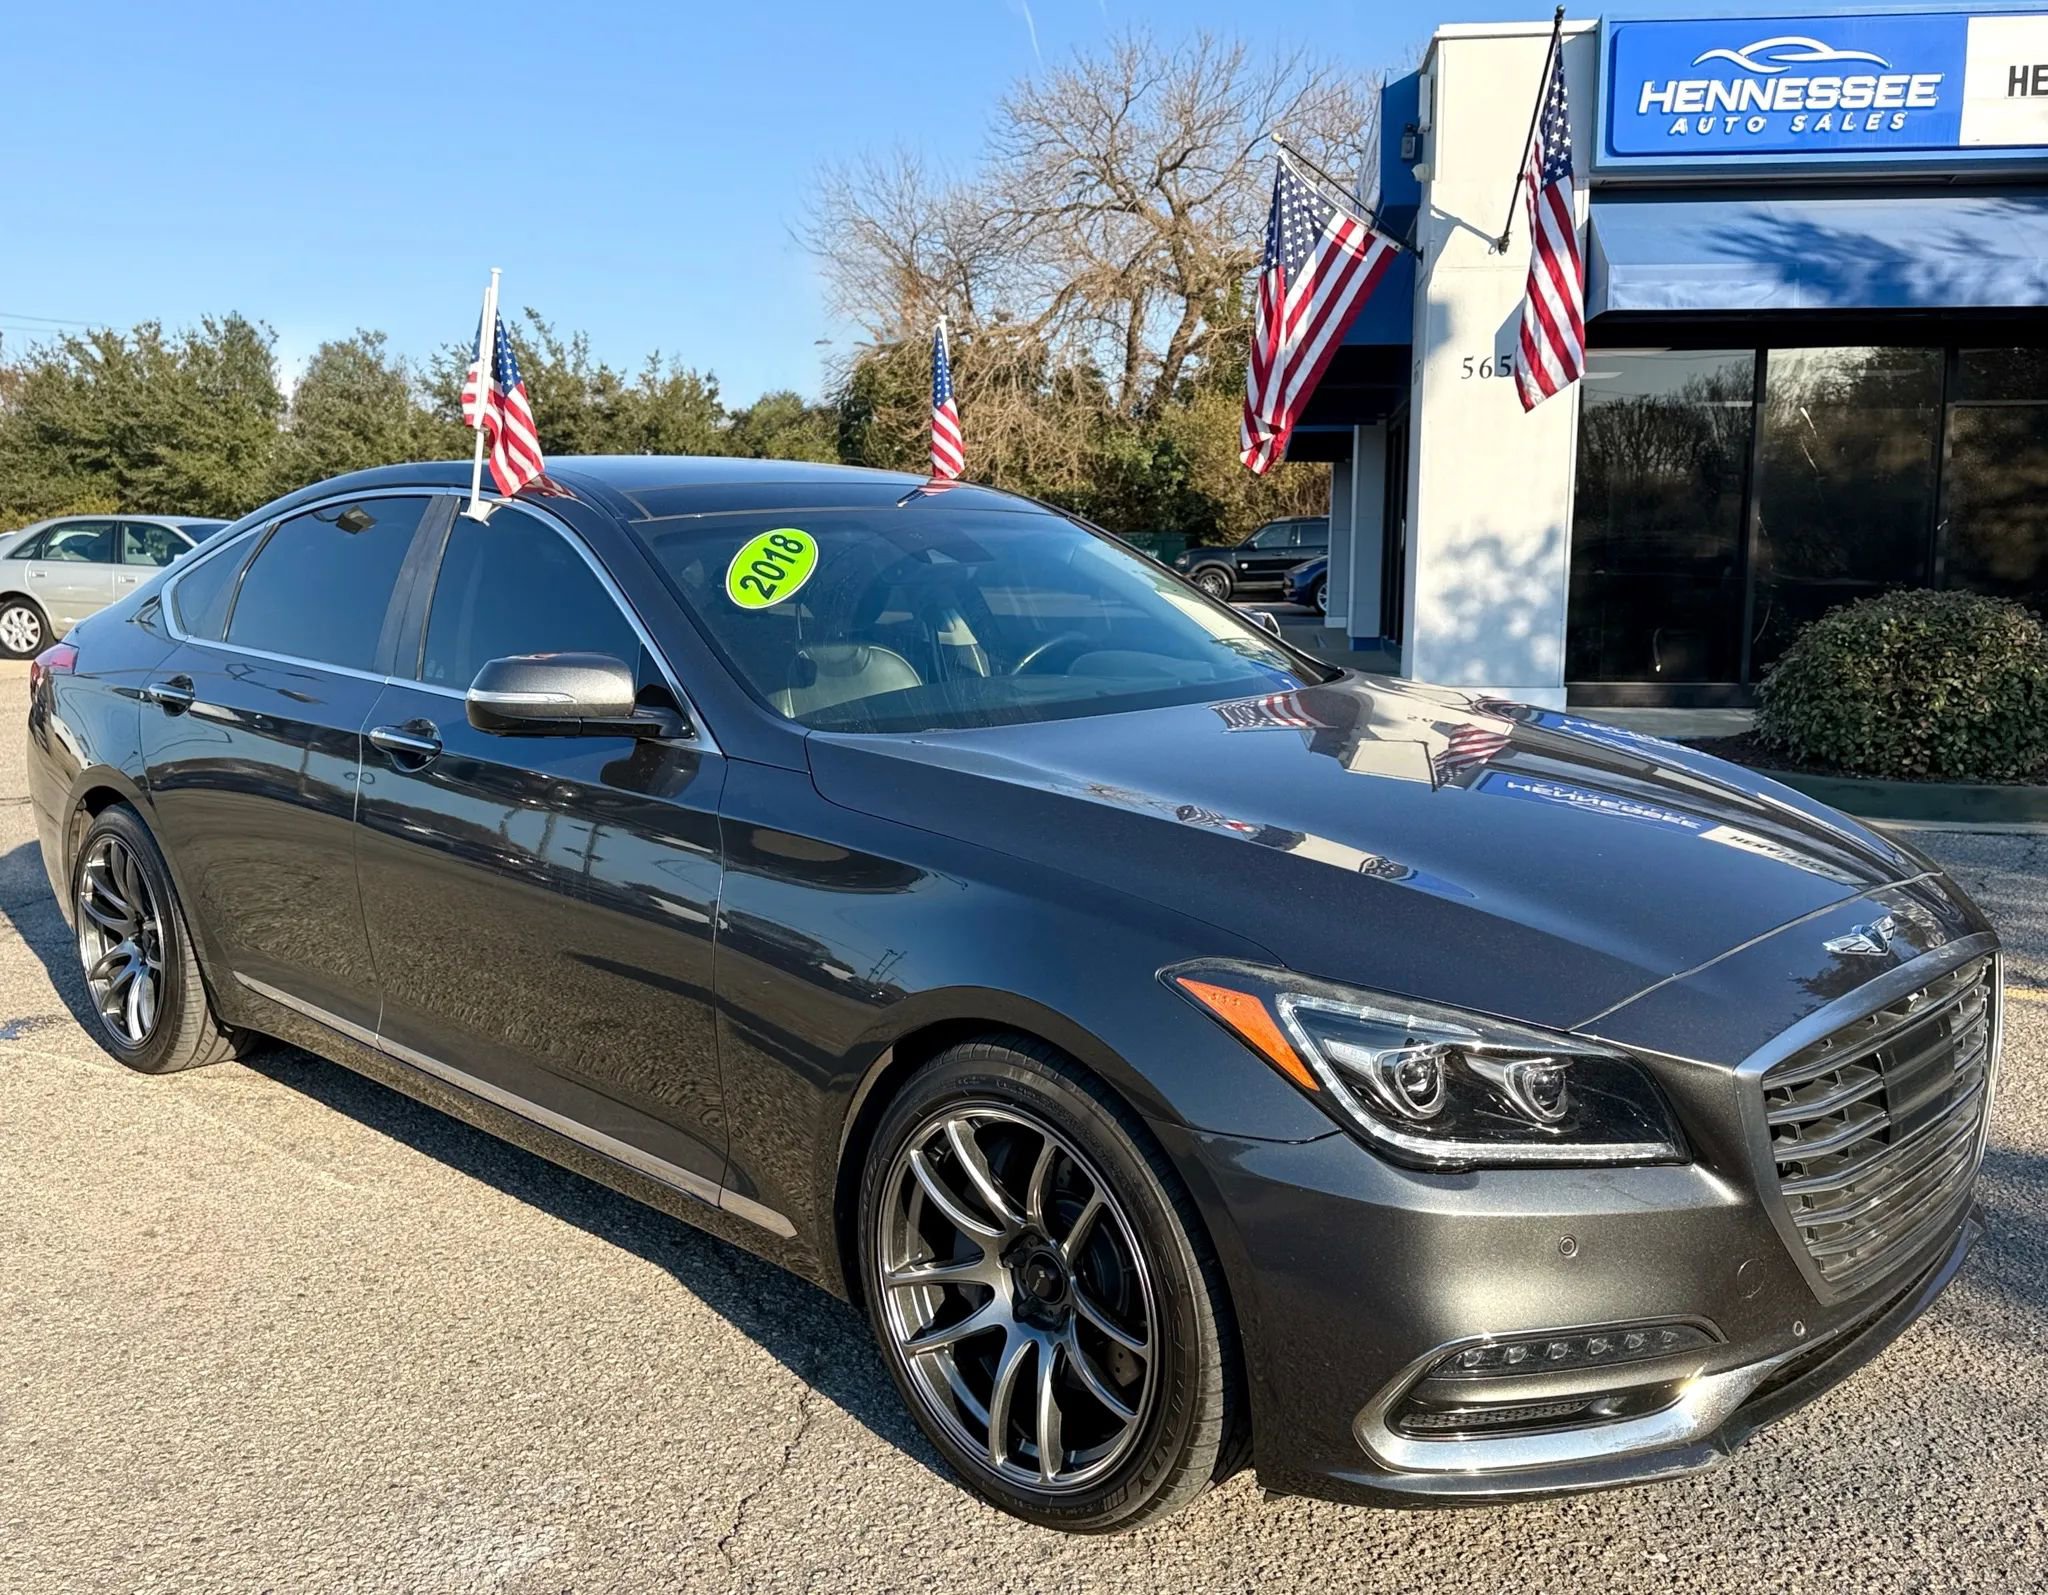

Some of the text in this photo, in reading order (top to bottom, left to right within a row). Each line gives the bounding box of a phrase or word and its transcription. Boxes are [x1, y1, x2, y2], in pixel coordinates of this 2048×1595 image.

[1637, 73, 1945, 114] HENNESSEE
[1669, 111, 1909, 136] AUTO SALES
[740, 534, 804, 601] 2018
